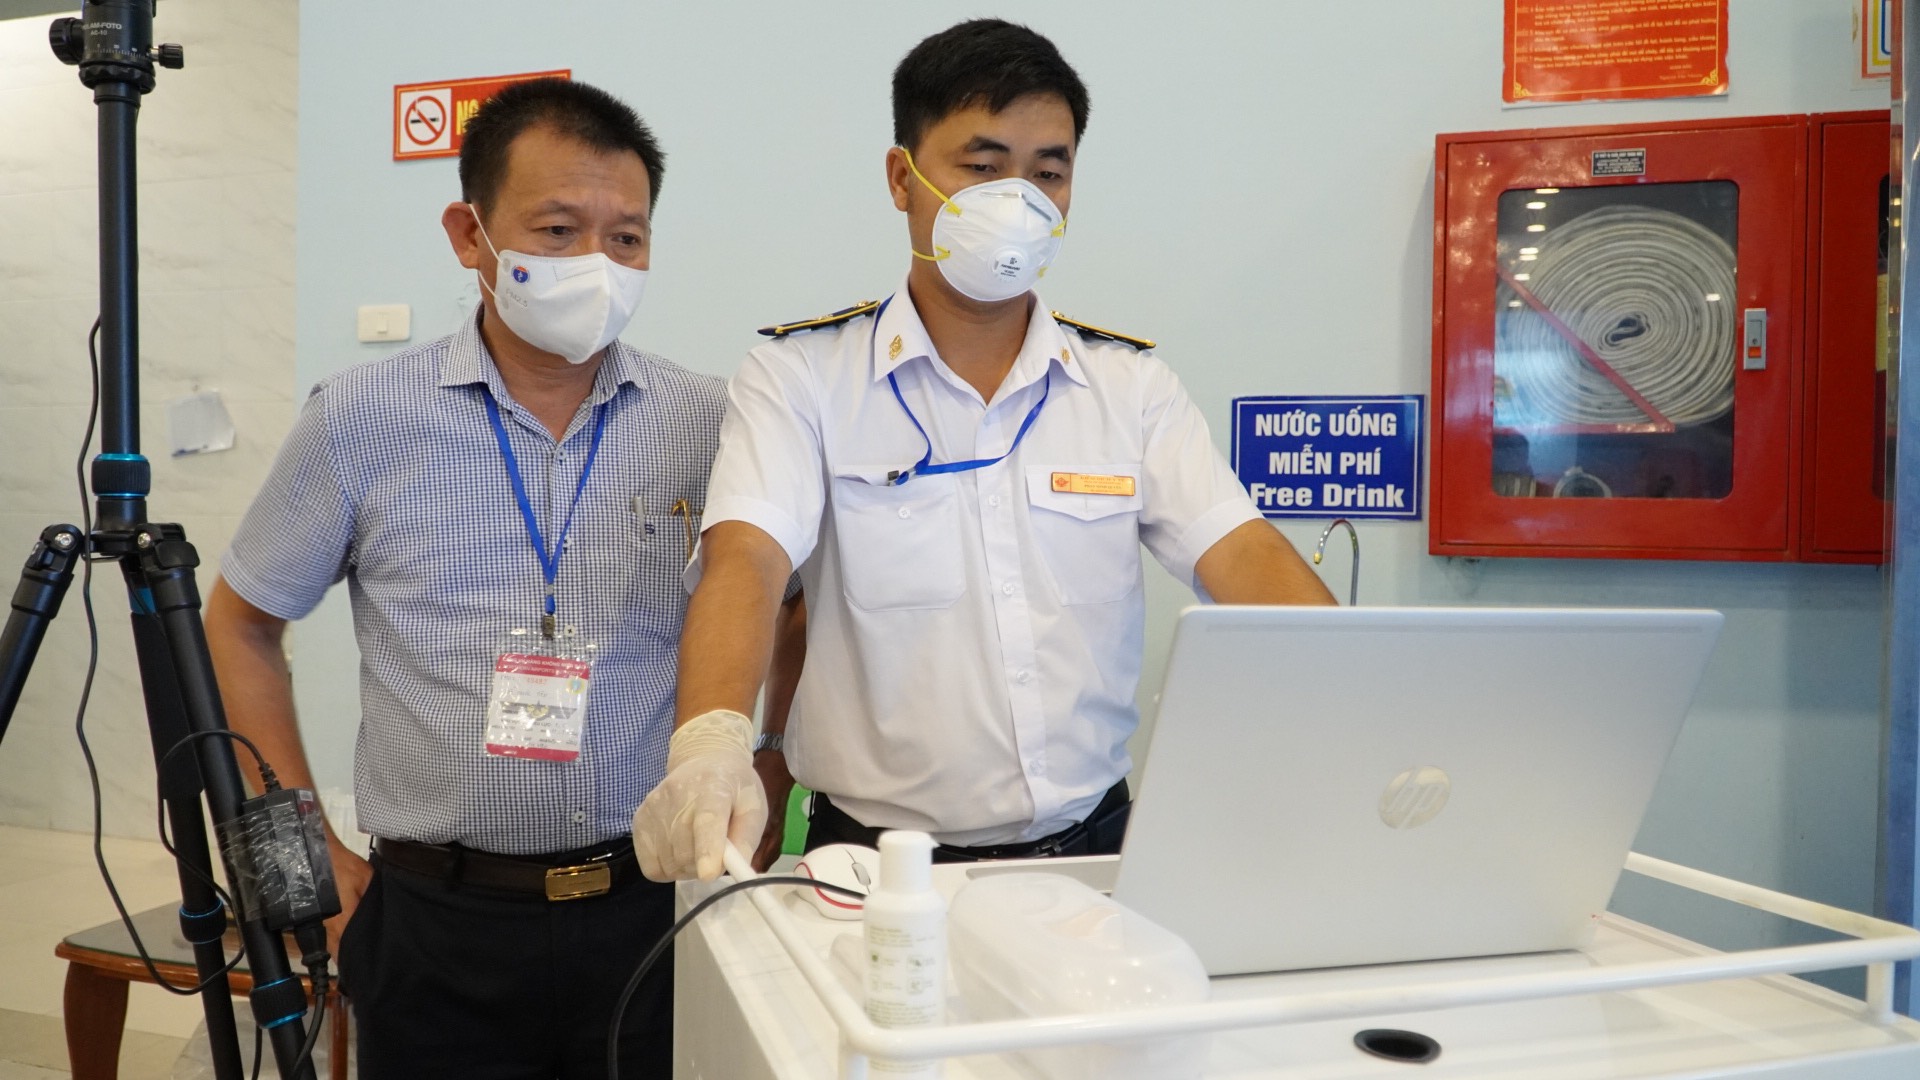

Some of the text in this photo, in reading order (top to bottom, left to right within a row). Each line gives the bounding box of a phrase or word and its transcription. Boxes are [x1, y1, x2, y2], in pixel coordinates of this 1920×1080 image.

[1255, 405, 1398, 437] NƯỚC UỐNG
[1269, 444, 1382, 476] MIỄN PHÍ
[1250, 483, 1405, 508] Free Drink
